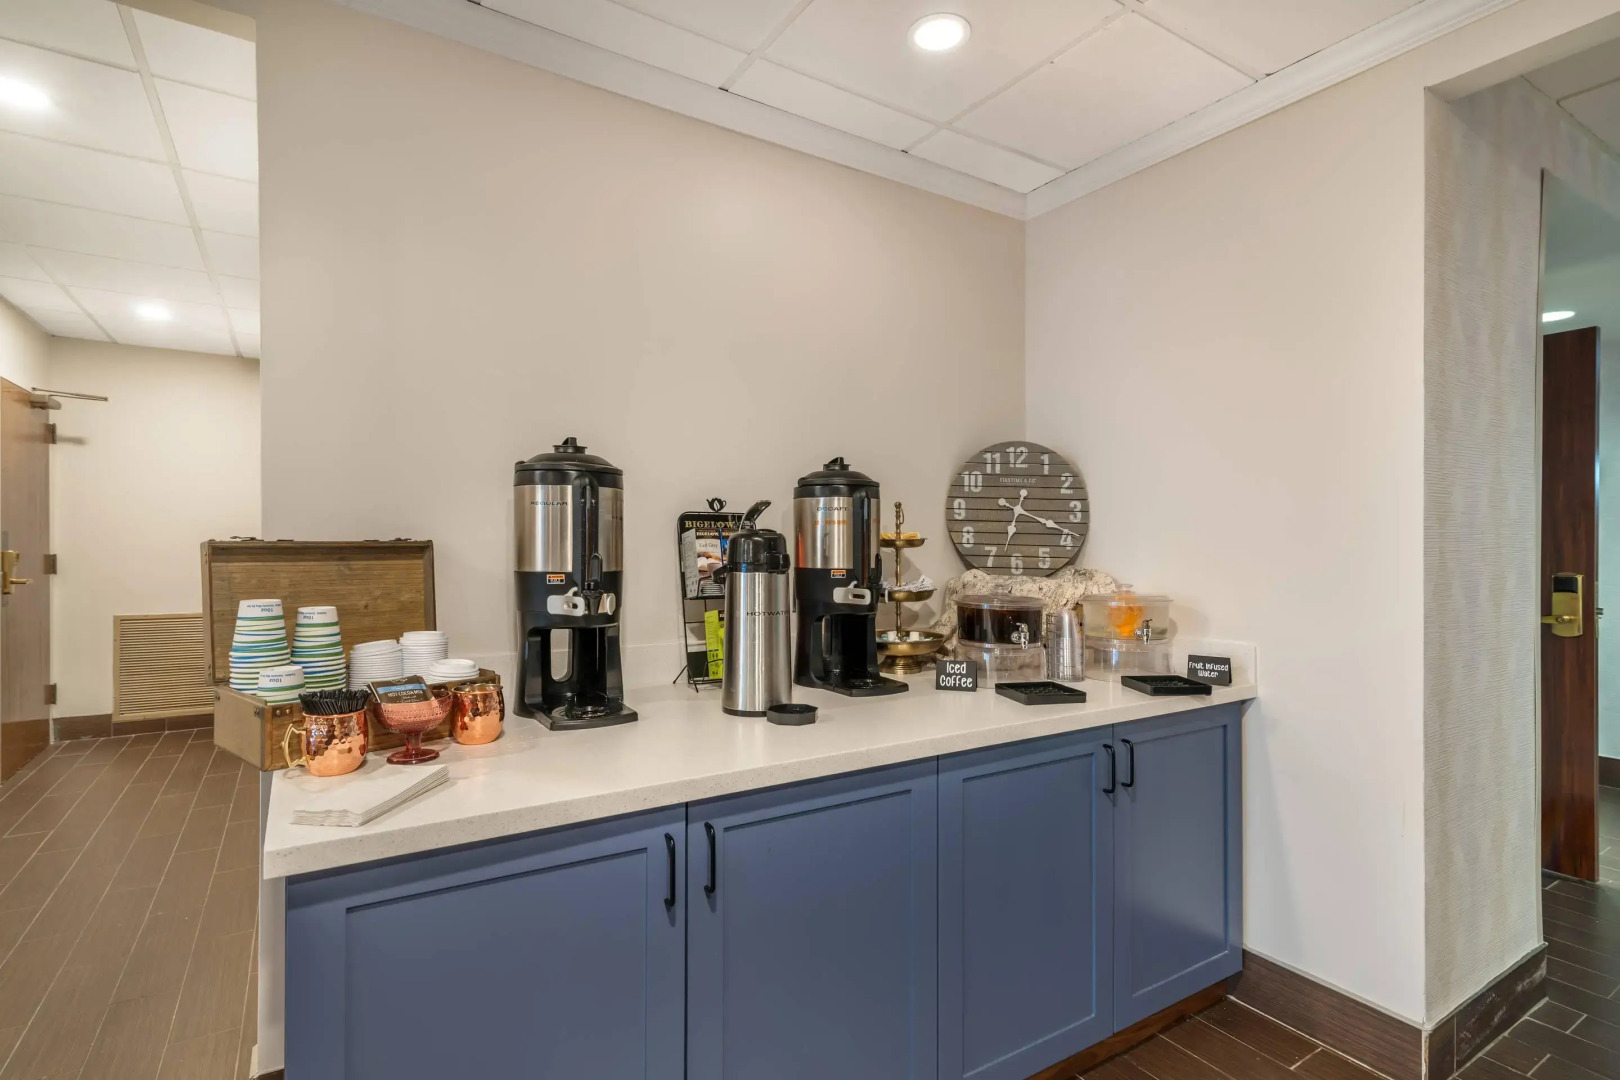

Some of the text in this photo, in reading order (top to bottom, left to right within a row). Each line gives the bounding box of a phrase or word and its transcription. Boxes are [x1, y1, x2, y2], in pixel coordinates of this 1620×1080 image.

[983, 452, 1001, 474] 11
[1006, 446, 1028, 468] 12
[1040, 453, 1050, 475] 1
[961, 471, 983, 493] 10
[1060, 472, 1074, 495] 2
[953, 498, 966, 520] 9
[1069, 501, 1082, 523] 3
[685, 520, 734, 528] BIGELOW
[962, 526, 975, 548] 8
[1060, 529, 1074, 550] 4
[984, 546, 997, 568] 7
[1010, 553, 1024, 575] 6
[1038, 547, 1051, 569] 5
[946, 661, 967, 674] Iced
[1189, 661, 1229, 671] Fruit Infused
[1197, 669, 1219, 678] Water
[940, 674, 973, 688] Coffee
